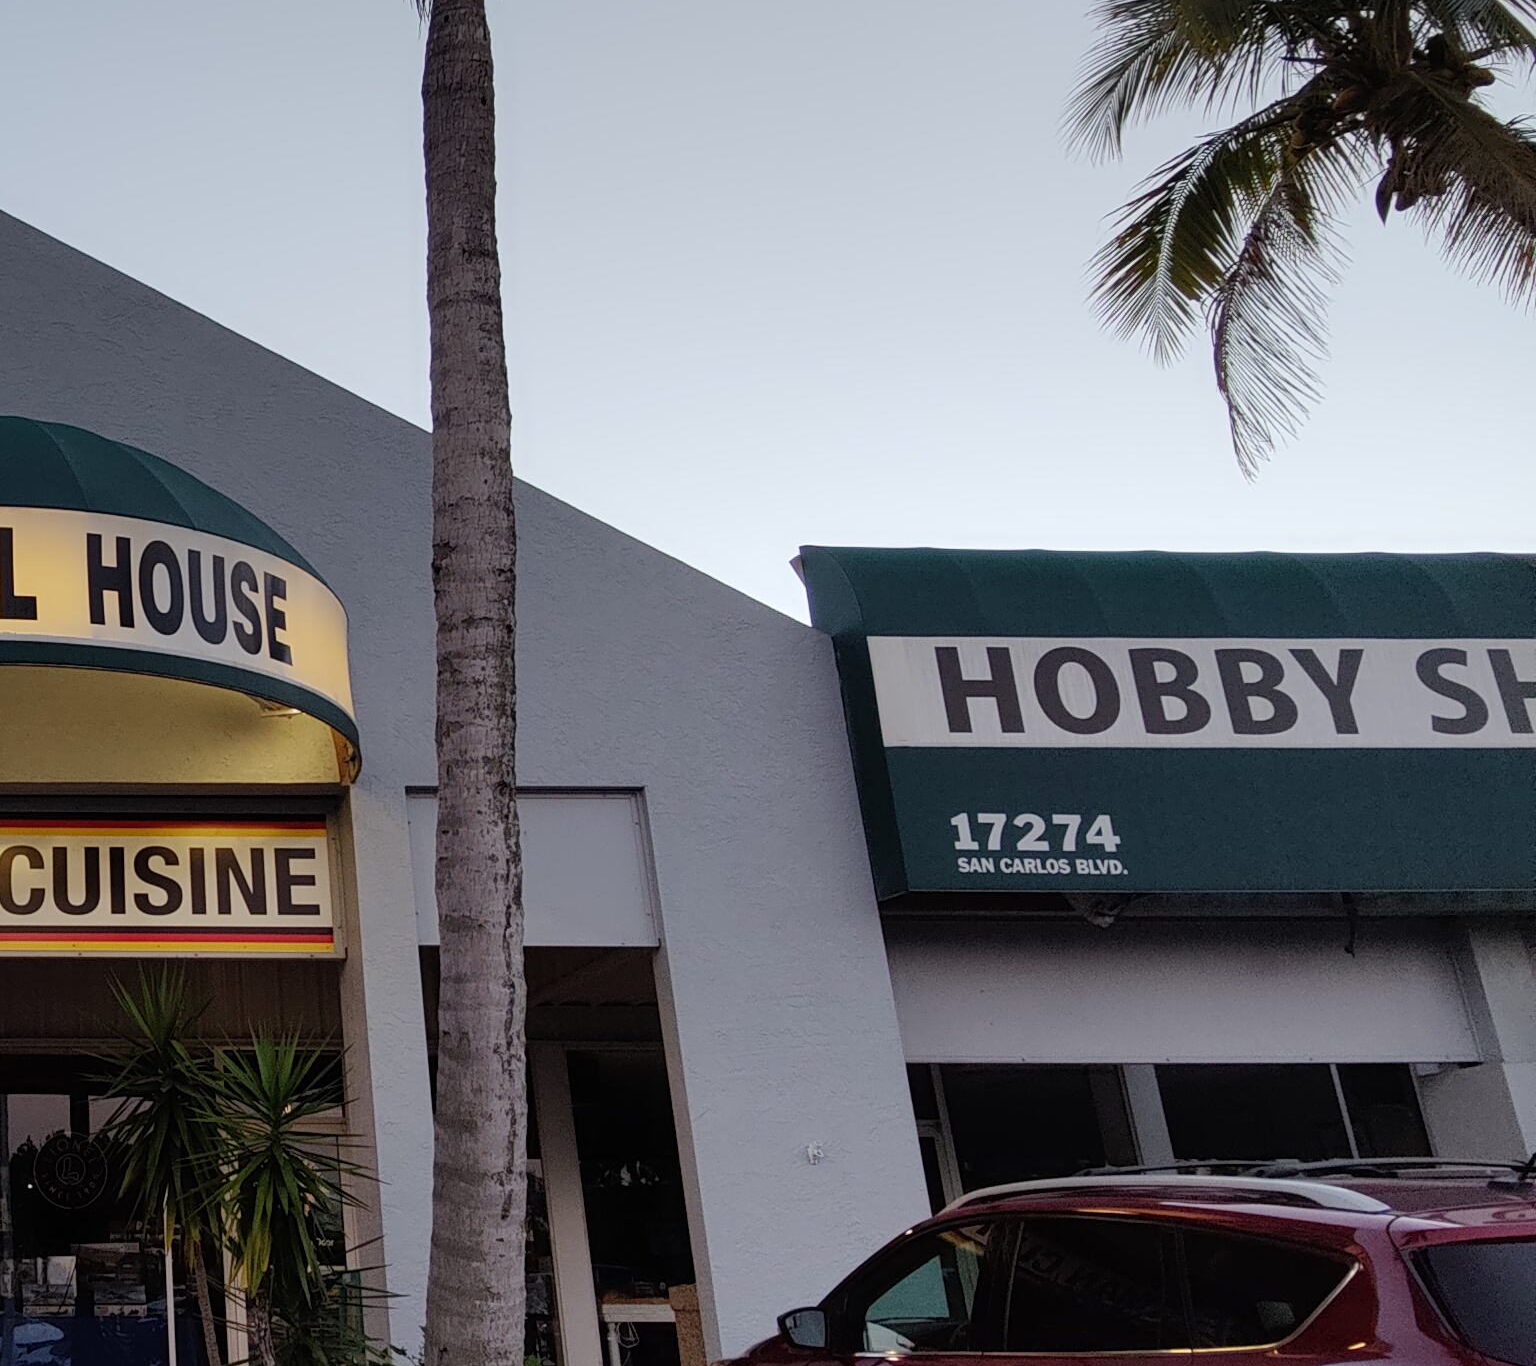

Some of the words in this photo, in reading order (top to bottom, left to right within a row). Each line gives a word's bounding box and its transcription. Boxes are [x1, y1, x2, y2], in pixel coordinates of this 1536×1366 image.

[85, 532, 293, 666] HOUSE
[934, 645, 1364, 735] HOBBY
[950, 812, 1121, 853] 17274
[957, 857, 995, 874] SAN
[1000, 857, 1071, 875] CARLOS
[1076, 858, 1129, 876] BLVD.
